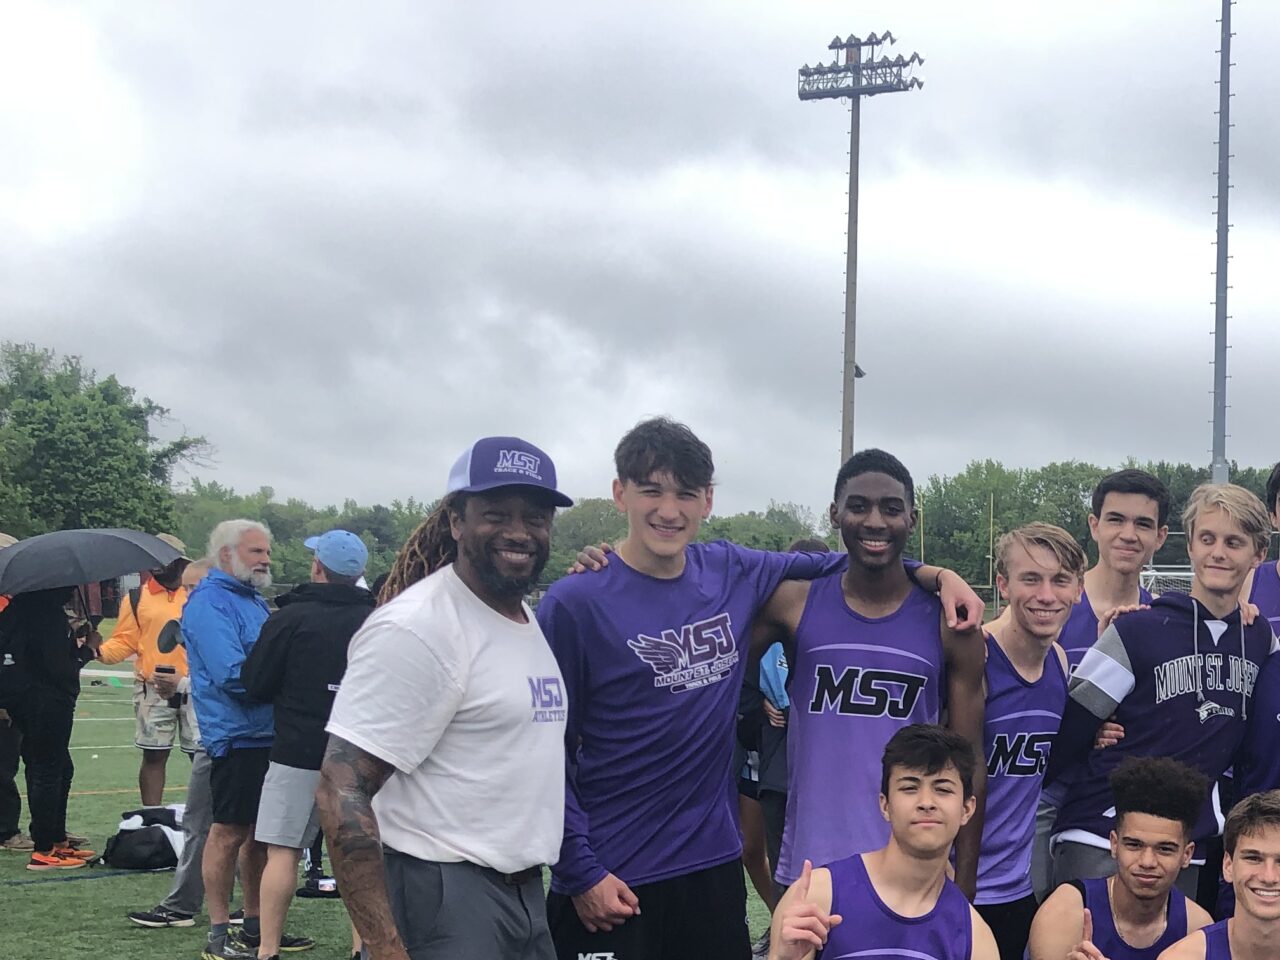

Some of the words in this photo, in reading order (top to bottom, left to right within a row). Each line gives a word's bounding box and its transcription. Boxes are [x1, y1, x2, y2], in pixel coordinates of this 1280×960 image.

[496, 450, 540, 474] MSJ
[661, 612, 736, 669] MSJ
[527, 677, 563, 708] MSJ
[654, 670, 693, 687] MOUNT
[694, 665, 710, 678] ST.
[808, 664, 928, 720] MSJ
[1154, 654, 1204, 704] MOUNT
[1206, 654, 1224, 690] ST.
